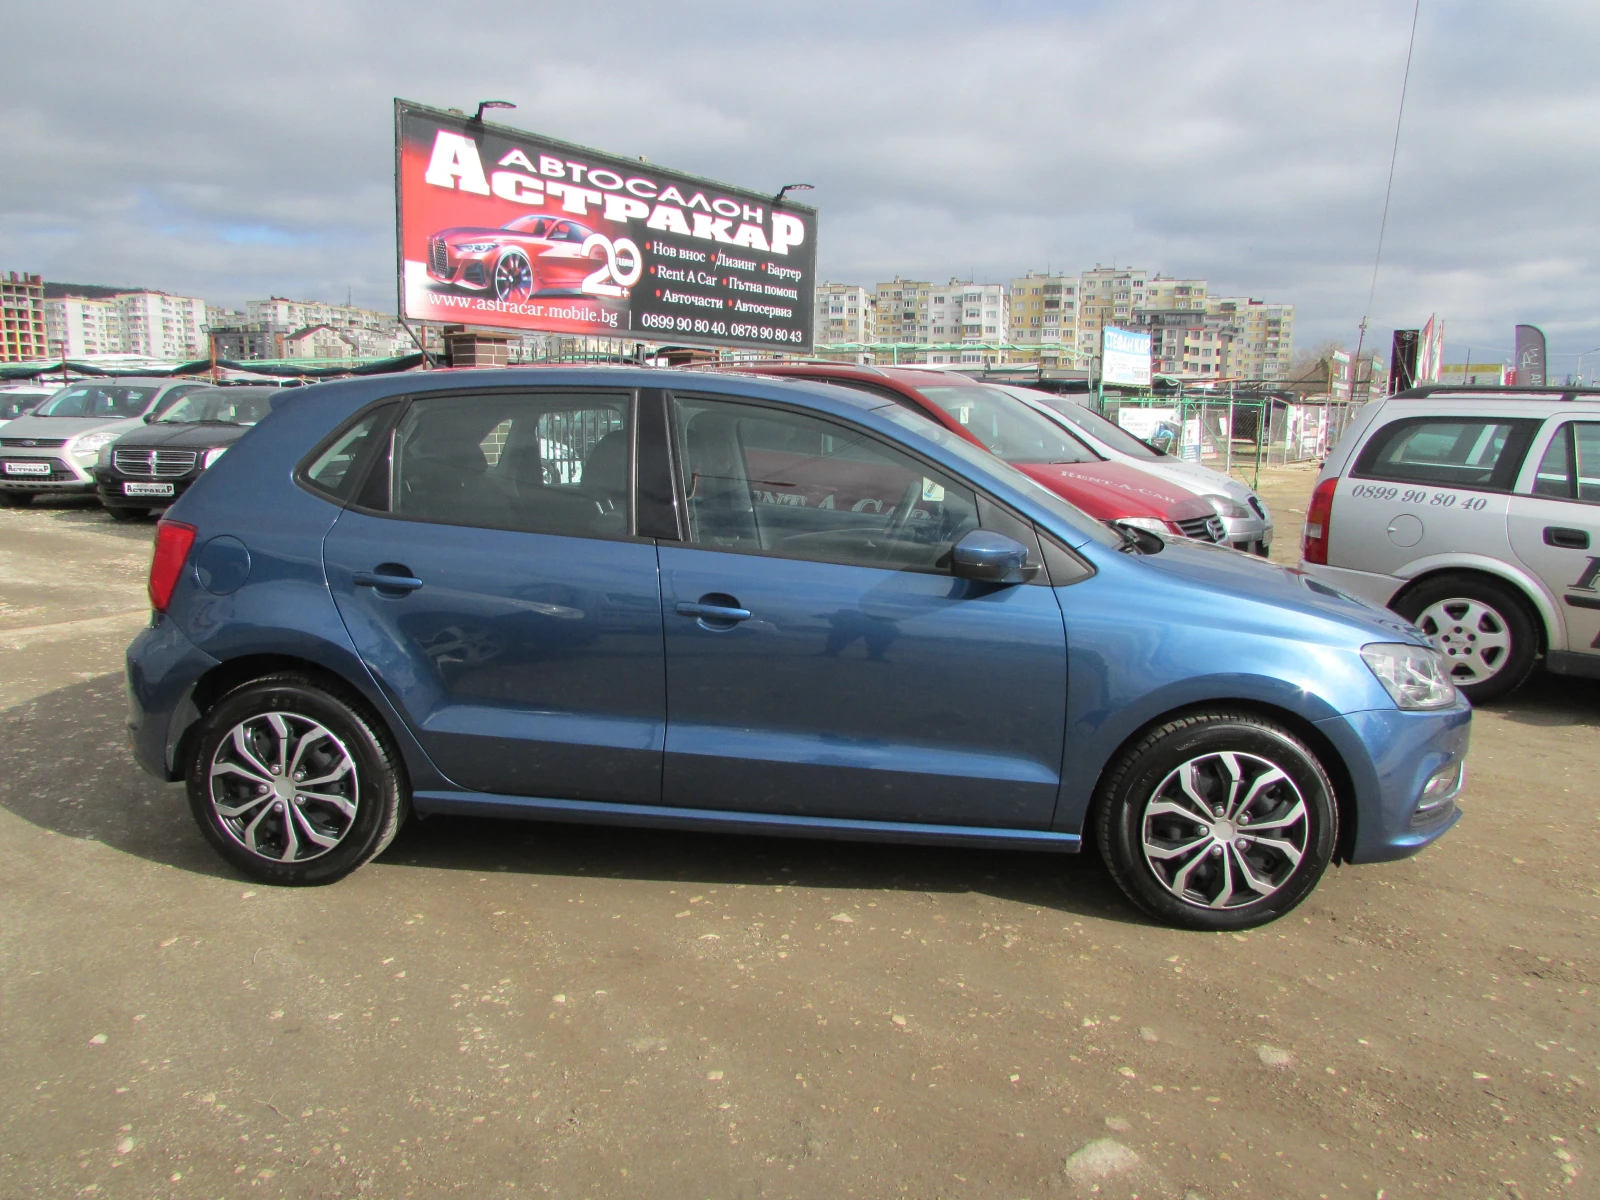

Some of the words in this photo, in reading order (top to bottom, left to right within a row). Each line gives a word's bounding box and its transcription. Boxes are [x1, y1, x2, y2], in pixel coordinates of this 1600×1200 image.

[498, 149, 763, 224] АВТОСАЛОН
[653, 241, 677, 258] Нов
[679, 250, 706, 262] внос
[717, 253, 757, 271] Лизинг
[657, 265, 685, 281] Rent
[686, 271, 695, 283] A
[698, 273, 717, 287] Car
[767, 263, 802, 281] Бартер
[663, 290, 723, 309] Авточасти
[729, 277, 762, 293] Пътна
[765, 285, 797, 300] помощ
[428, 293, 618, 327] www.astracar.mobile.bg
[735, 300, 792, 318] Автосервиз
[642, 314, 674, 329] 0899
[676, 318, 692, 331] 90
[694, 320, 709, 332] 80
[711, 322, 728, 336] 40,
[731, 324, 757, 337] 0878
[760, 327, 773, 339] 90
[775, 329, 788, 341] 80
[789, 331, 802, 342] 43
[1104, 331, 1134, 353] СТЕФАН
[1134, 338, 1151, 354] КАР
[1352, 485, 1398, 500] 0899
[1401, 489, 1426, 503] 90
[1429, 493, 1456, 507] 80
[1460, 497, 1487, 511] 40
